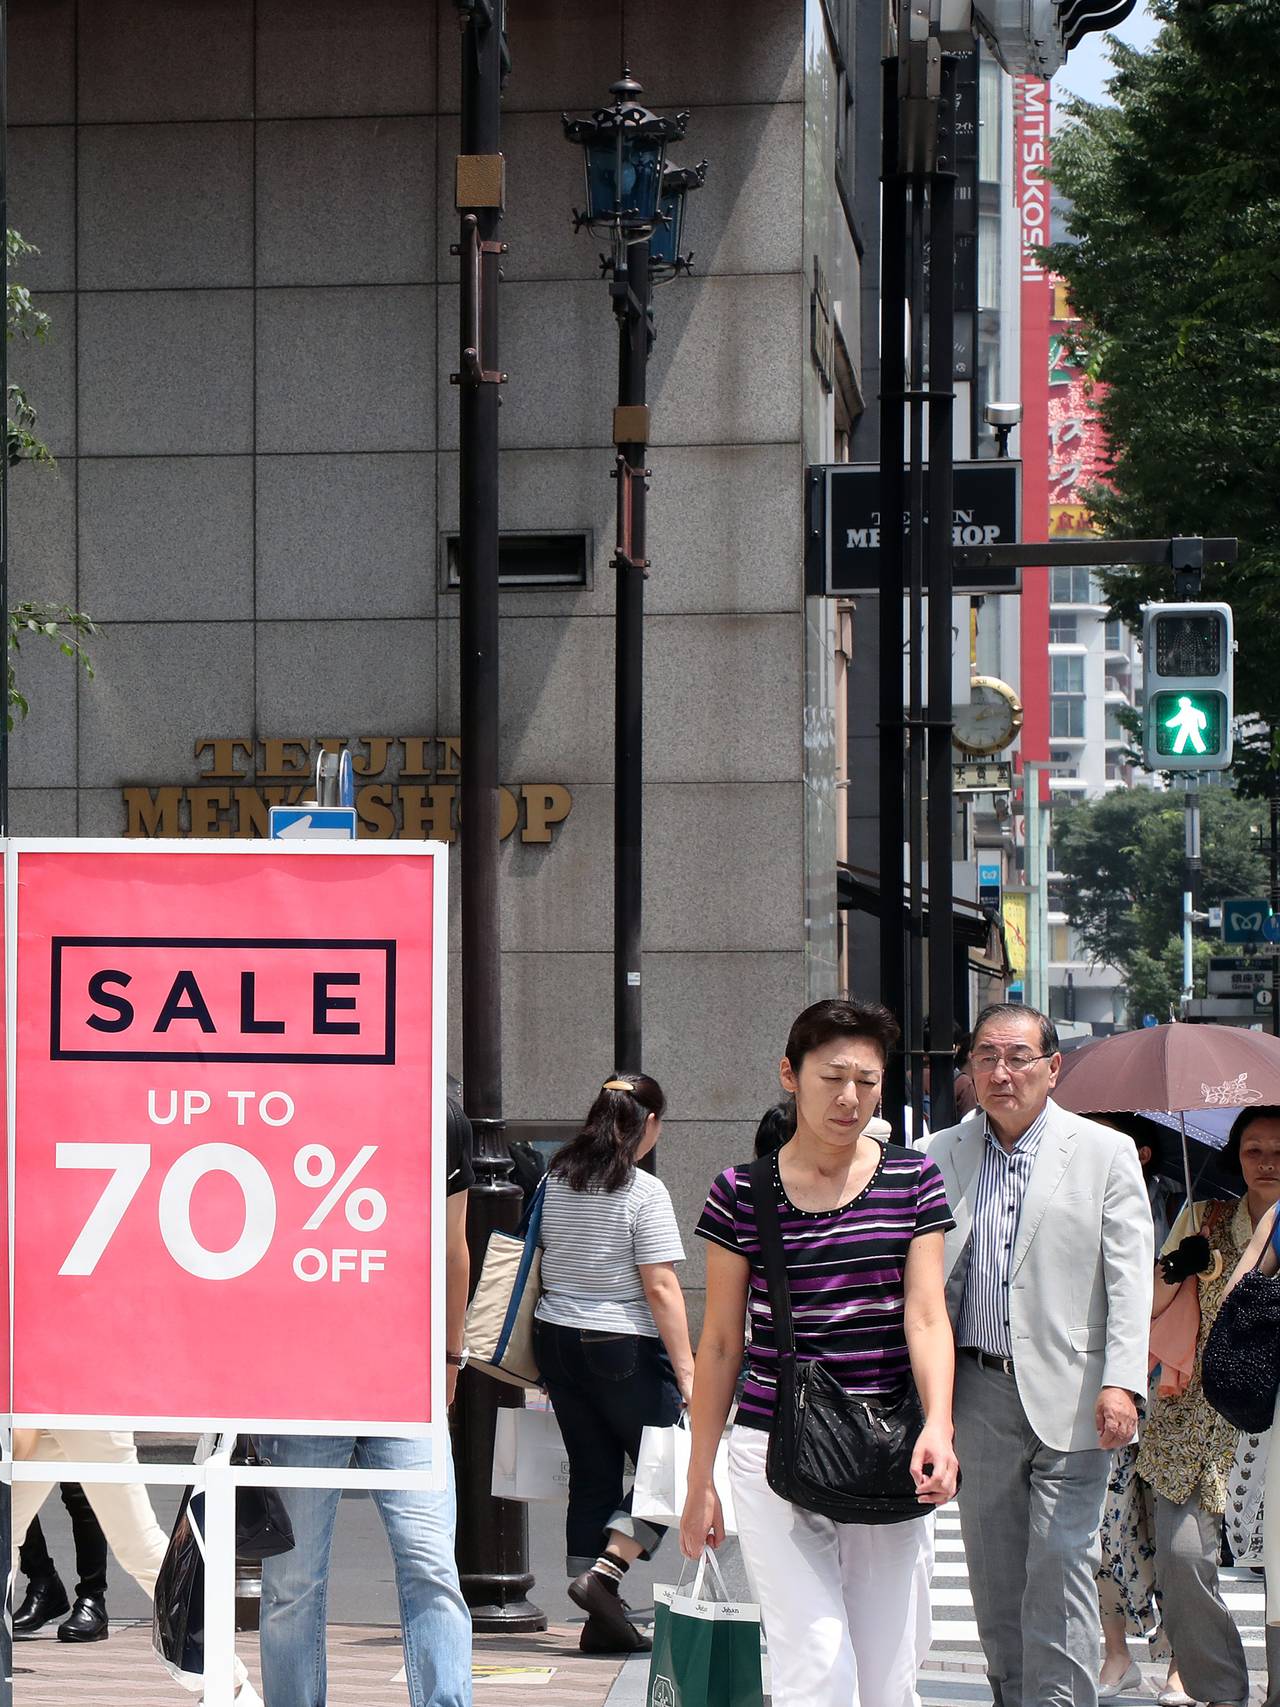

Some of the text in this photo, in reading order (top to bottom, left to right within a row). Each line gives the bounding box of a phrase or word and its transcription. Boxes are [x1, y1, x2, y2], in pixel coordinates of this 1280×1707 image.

[1023, 83, 1045, 282] MITSUKOSHI
[123, 786, 318, 839] MEN'
[86, 969, 362, 1036] SALE
[147, 1091, 296, 1127] UP TO
[55, 1142, 388, 1282] 70%
[292, 1248, 387, 1284] OFF
